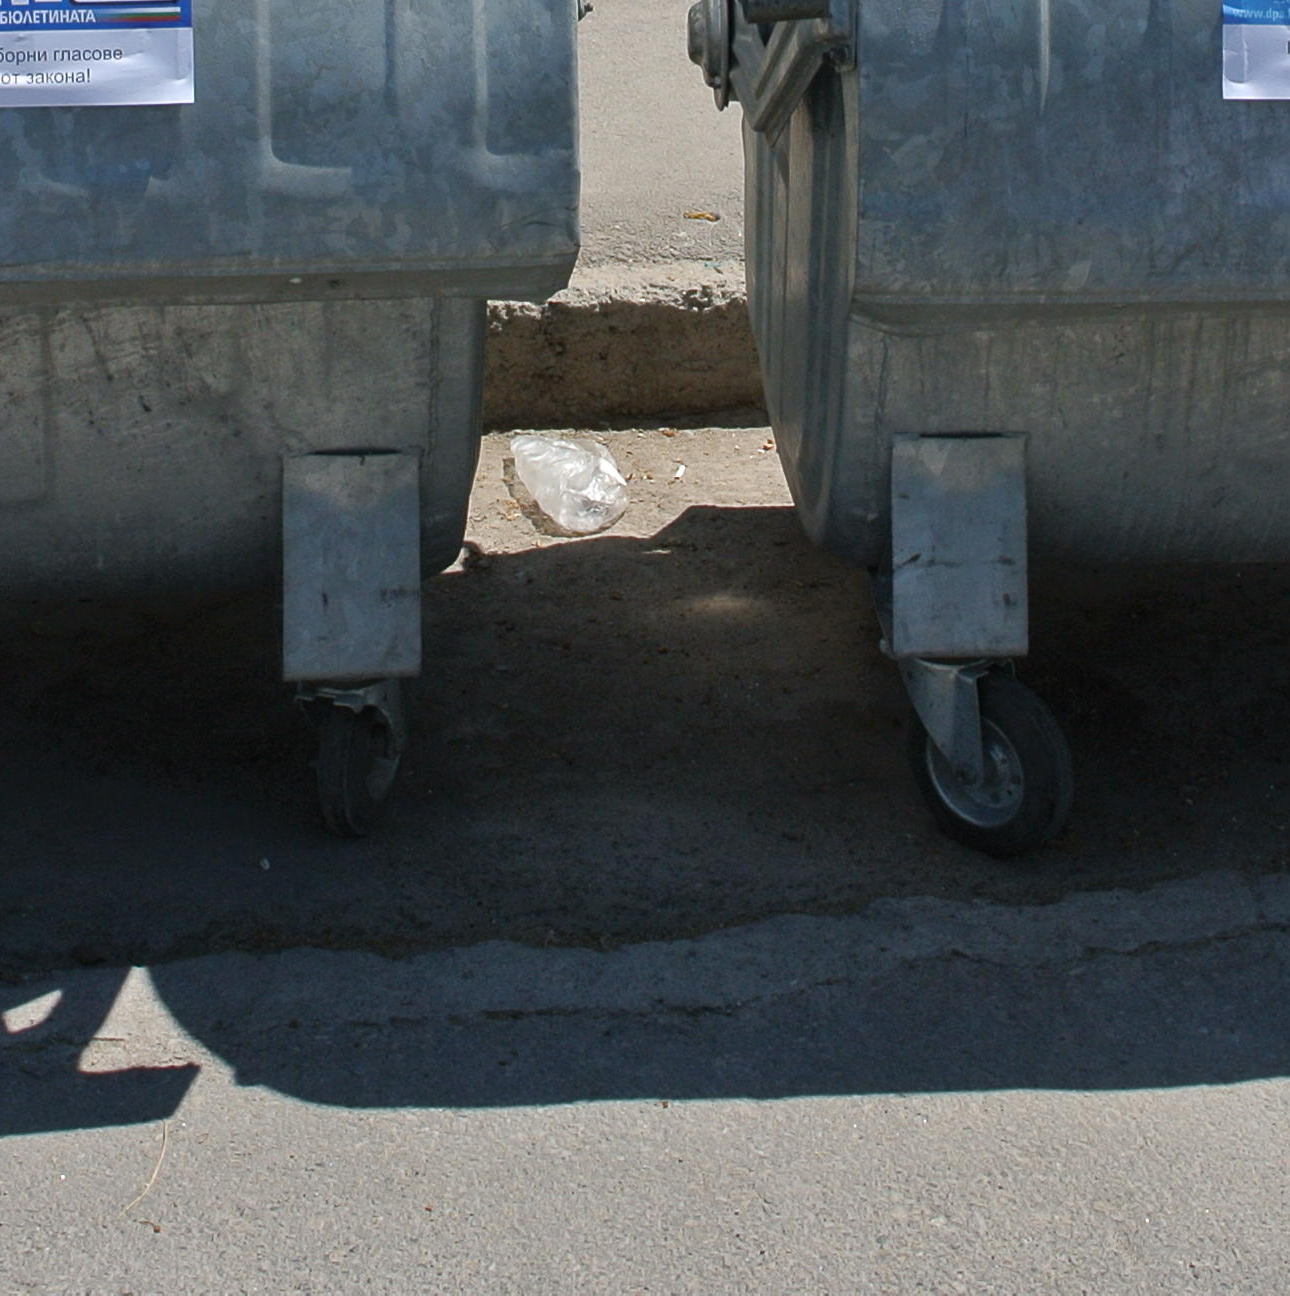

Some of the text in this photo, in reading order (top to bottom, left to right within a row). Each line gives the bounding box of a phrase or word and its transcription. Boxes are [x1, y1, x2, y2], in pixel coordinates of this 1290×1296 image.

[0, 10, 96, 25] БЮЛЕТИНАТА
[53, 50, 123, 62] гласове
[1, 73, 21, 85] от
[26, 69, 91, 85] закона!
